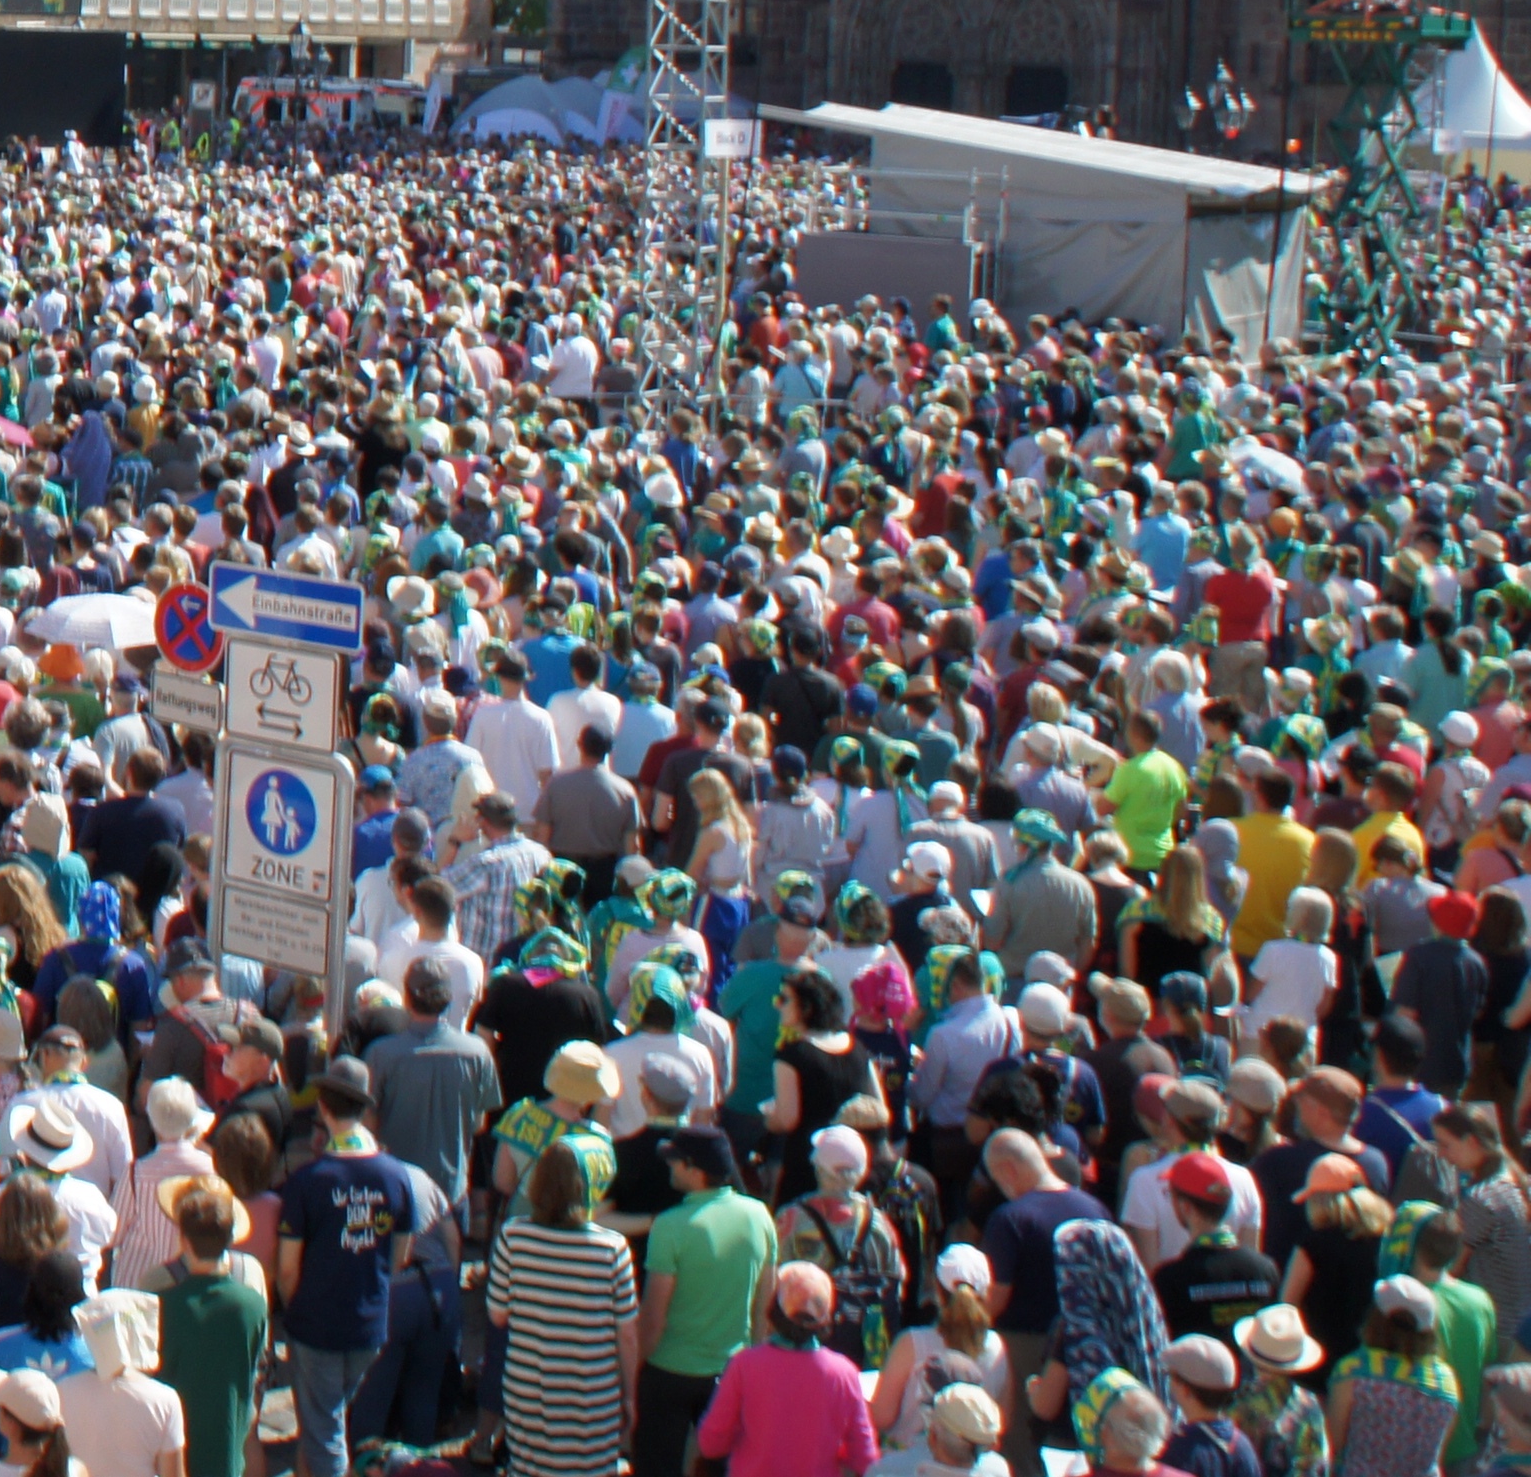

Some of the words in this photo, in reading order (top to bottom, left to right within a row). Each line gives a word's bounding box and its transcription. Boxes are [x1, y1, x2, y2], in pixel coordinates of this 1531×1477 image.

[252, 592, 352, 624] Einbahnstraße
[155, 687, 216, 720] Rettungsweg
[251, 853, 305, 887] ZONE
